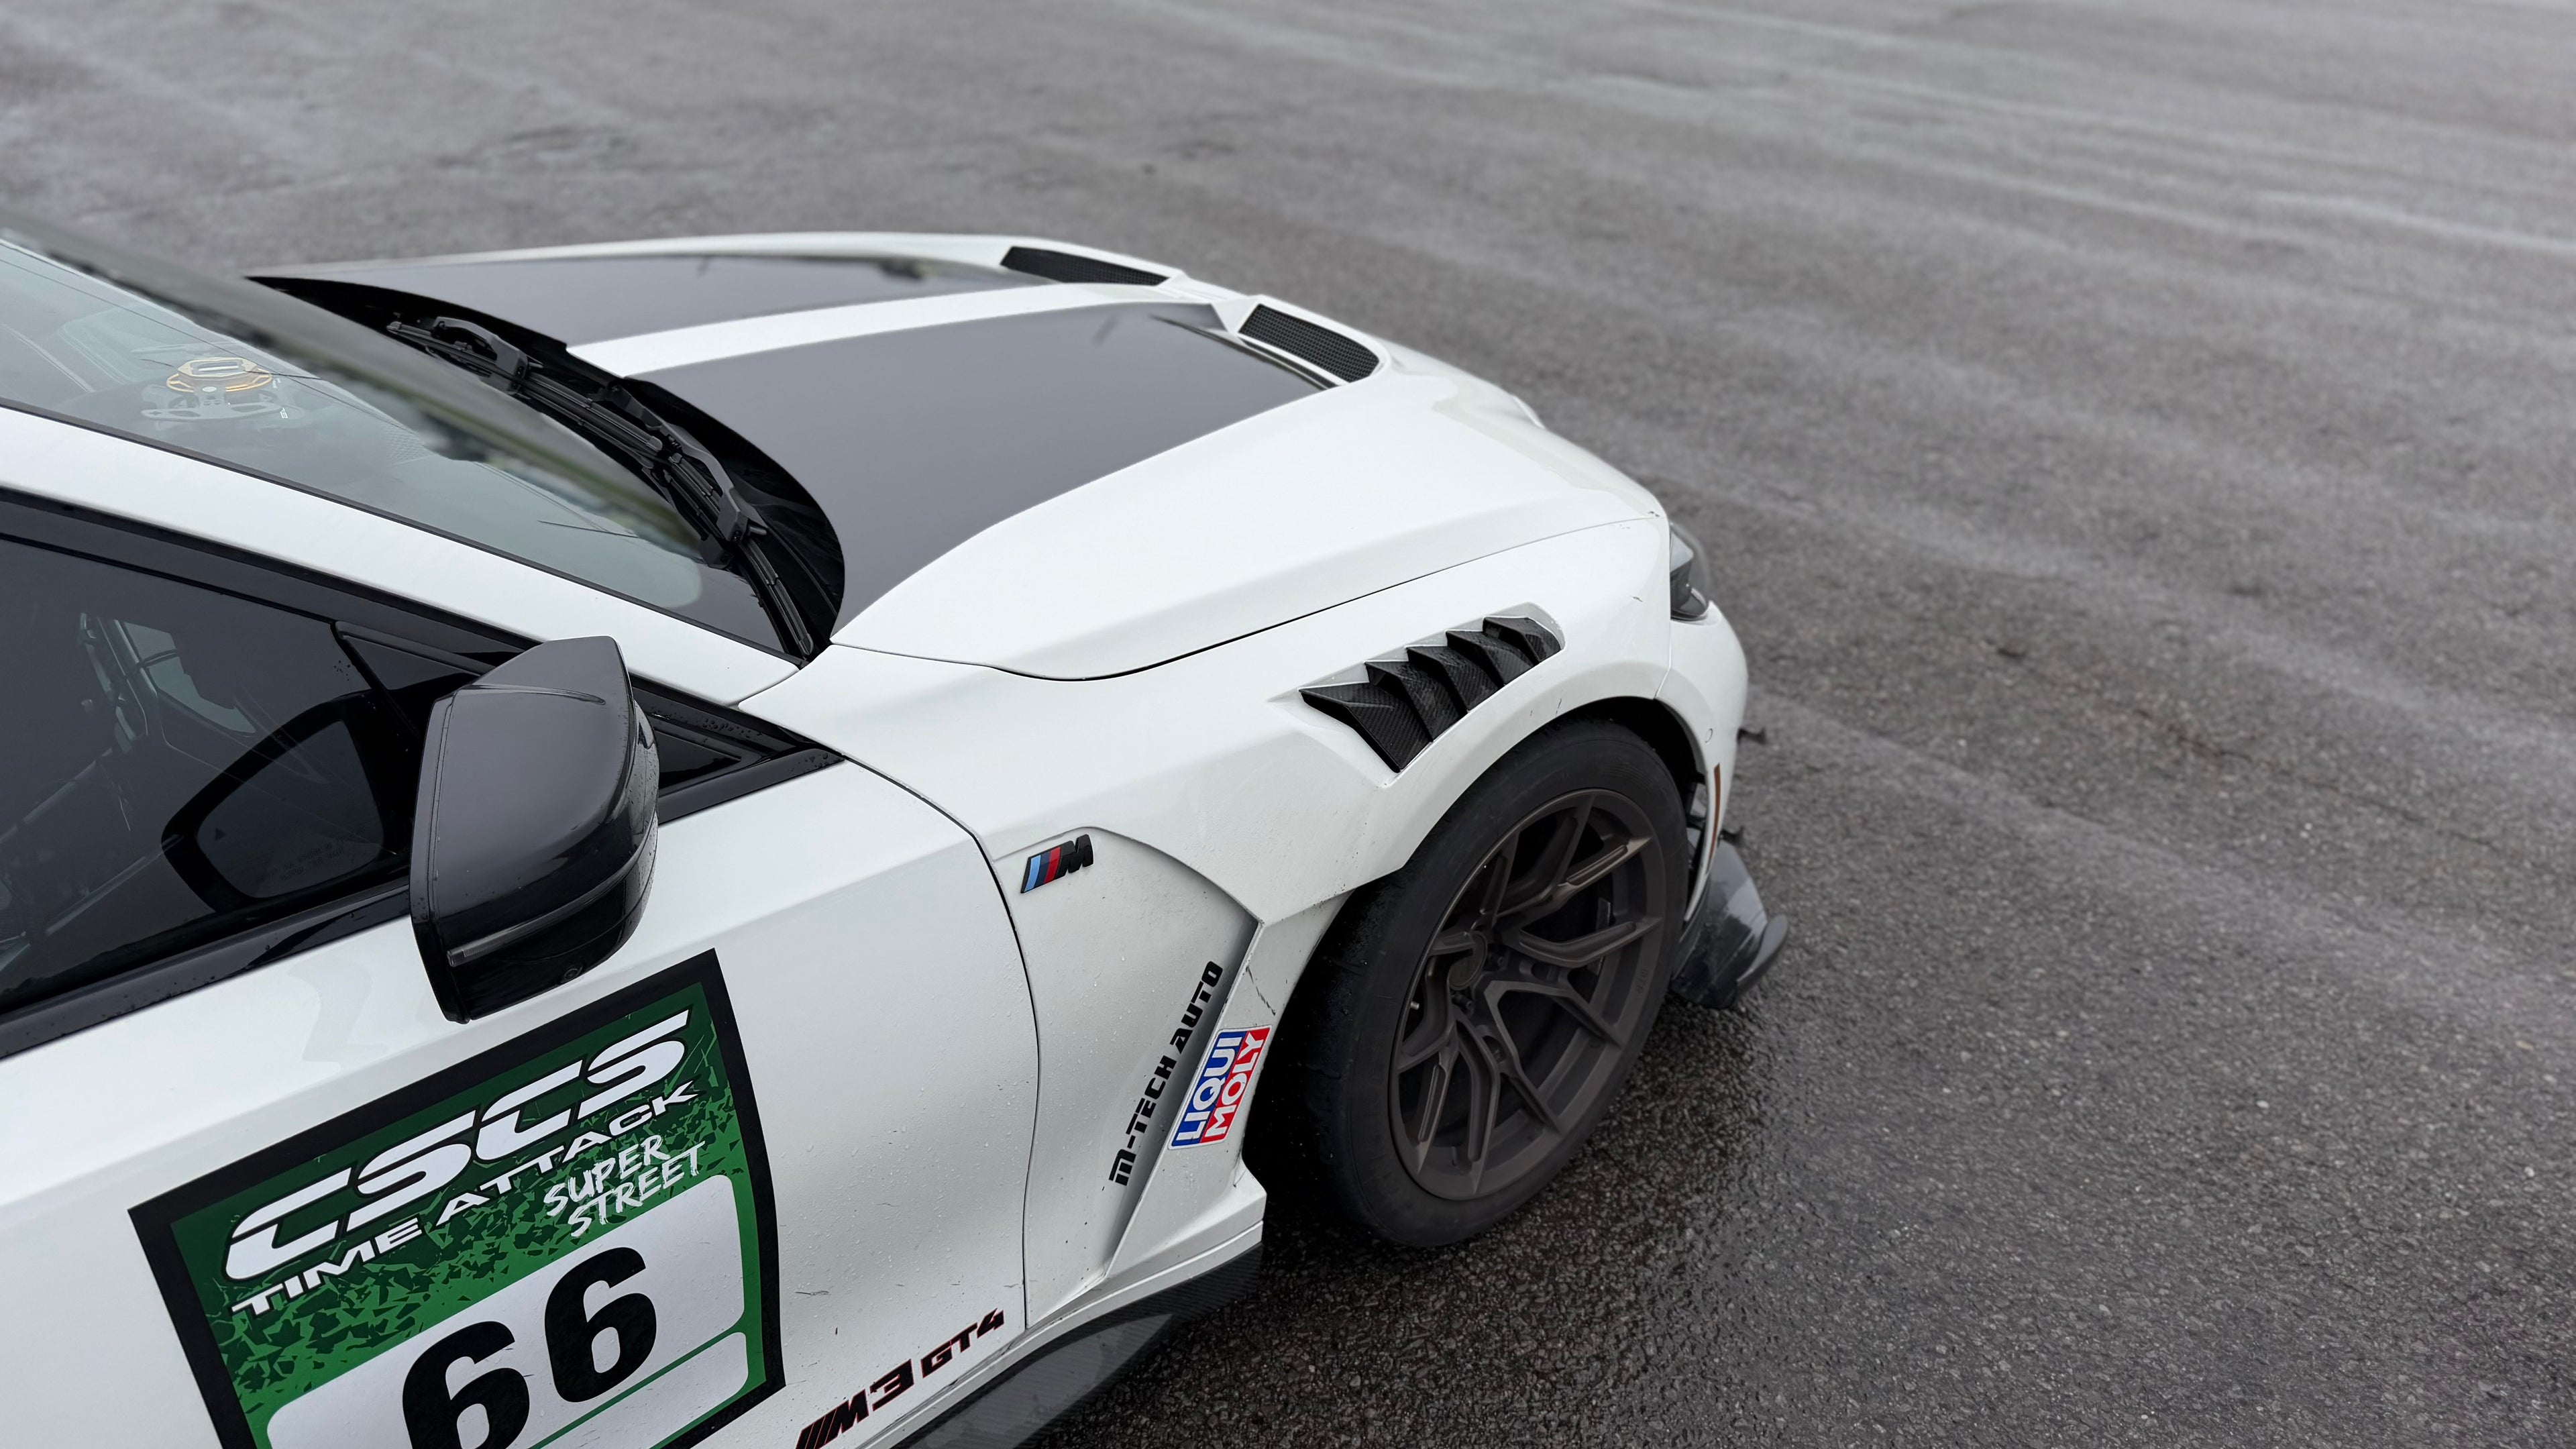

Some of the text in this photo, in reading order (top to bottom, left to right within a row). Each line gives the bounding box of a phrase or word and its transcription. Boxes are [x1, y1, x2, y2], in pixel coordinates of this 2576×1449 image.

[1169, 961, 1224, 1055] AUTO
[1176, 1036, 1243, 1140] LIQUI
[1204, 1032, 1265, 1137] MOLY
[225, 1009, 690, 1279] CSCS
[544, 1135, 671, 1217] SUPER
[568, 1140, 706, 1237] STREET
[231, 1080, 698, 1315] TIME ATTACK
[402, 1246, 657, 1449] 66
[920, 1307, 1004, 1378] GT4
